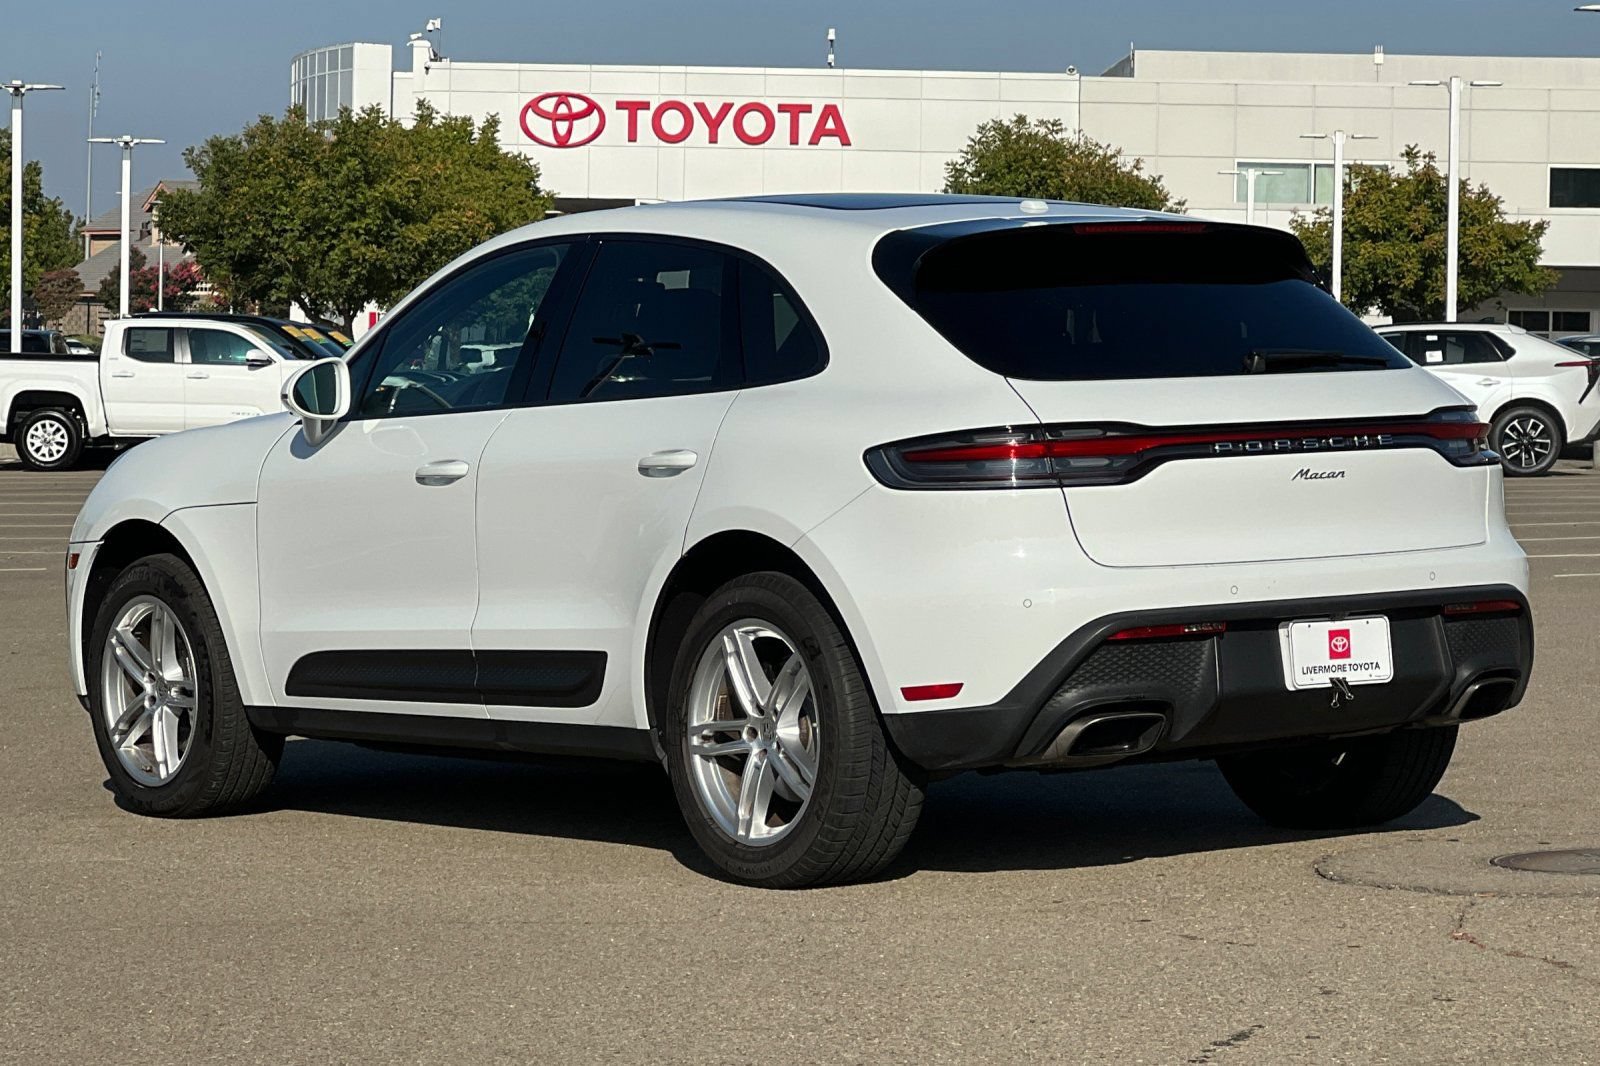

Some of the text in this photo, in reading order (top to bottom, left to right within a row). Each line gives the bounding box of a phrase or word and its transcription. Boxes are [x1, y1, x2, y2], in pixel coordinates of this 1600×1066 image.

[616, 100, 852, 147] TOYOTA
[1214, 434, 1393, 453] PORSCHE
[1291, 468, 1346, 481] Macan
[1301, 661, 1381, 675] LIVERMORE TOYOTA
